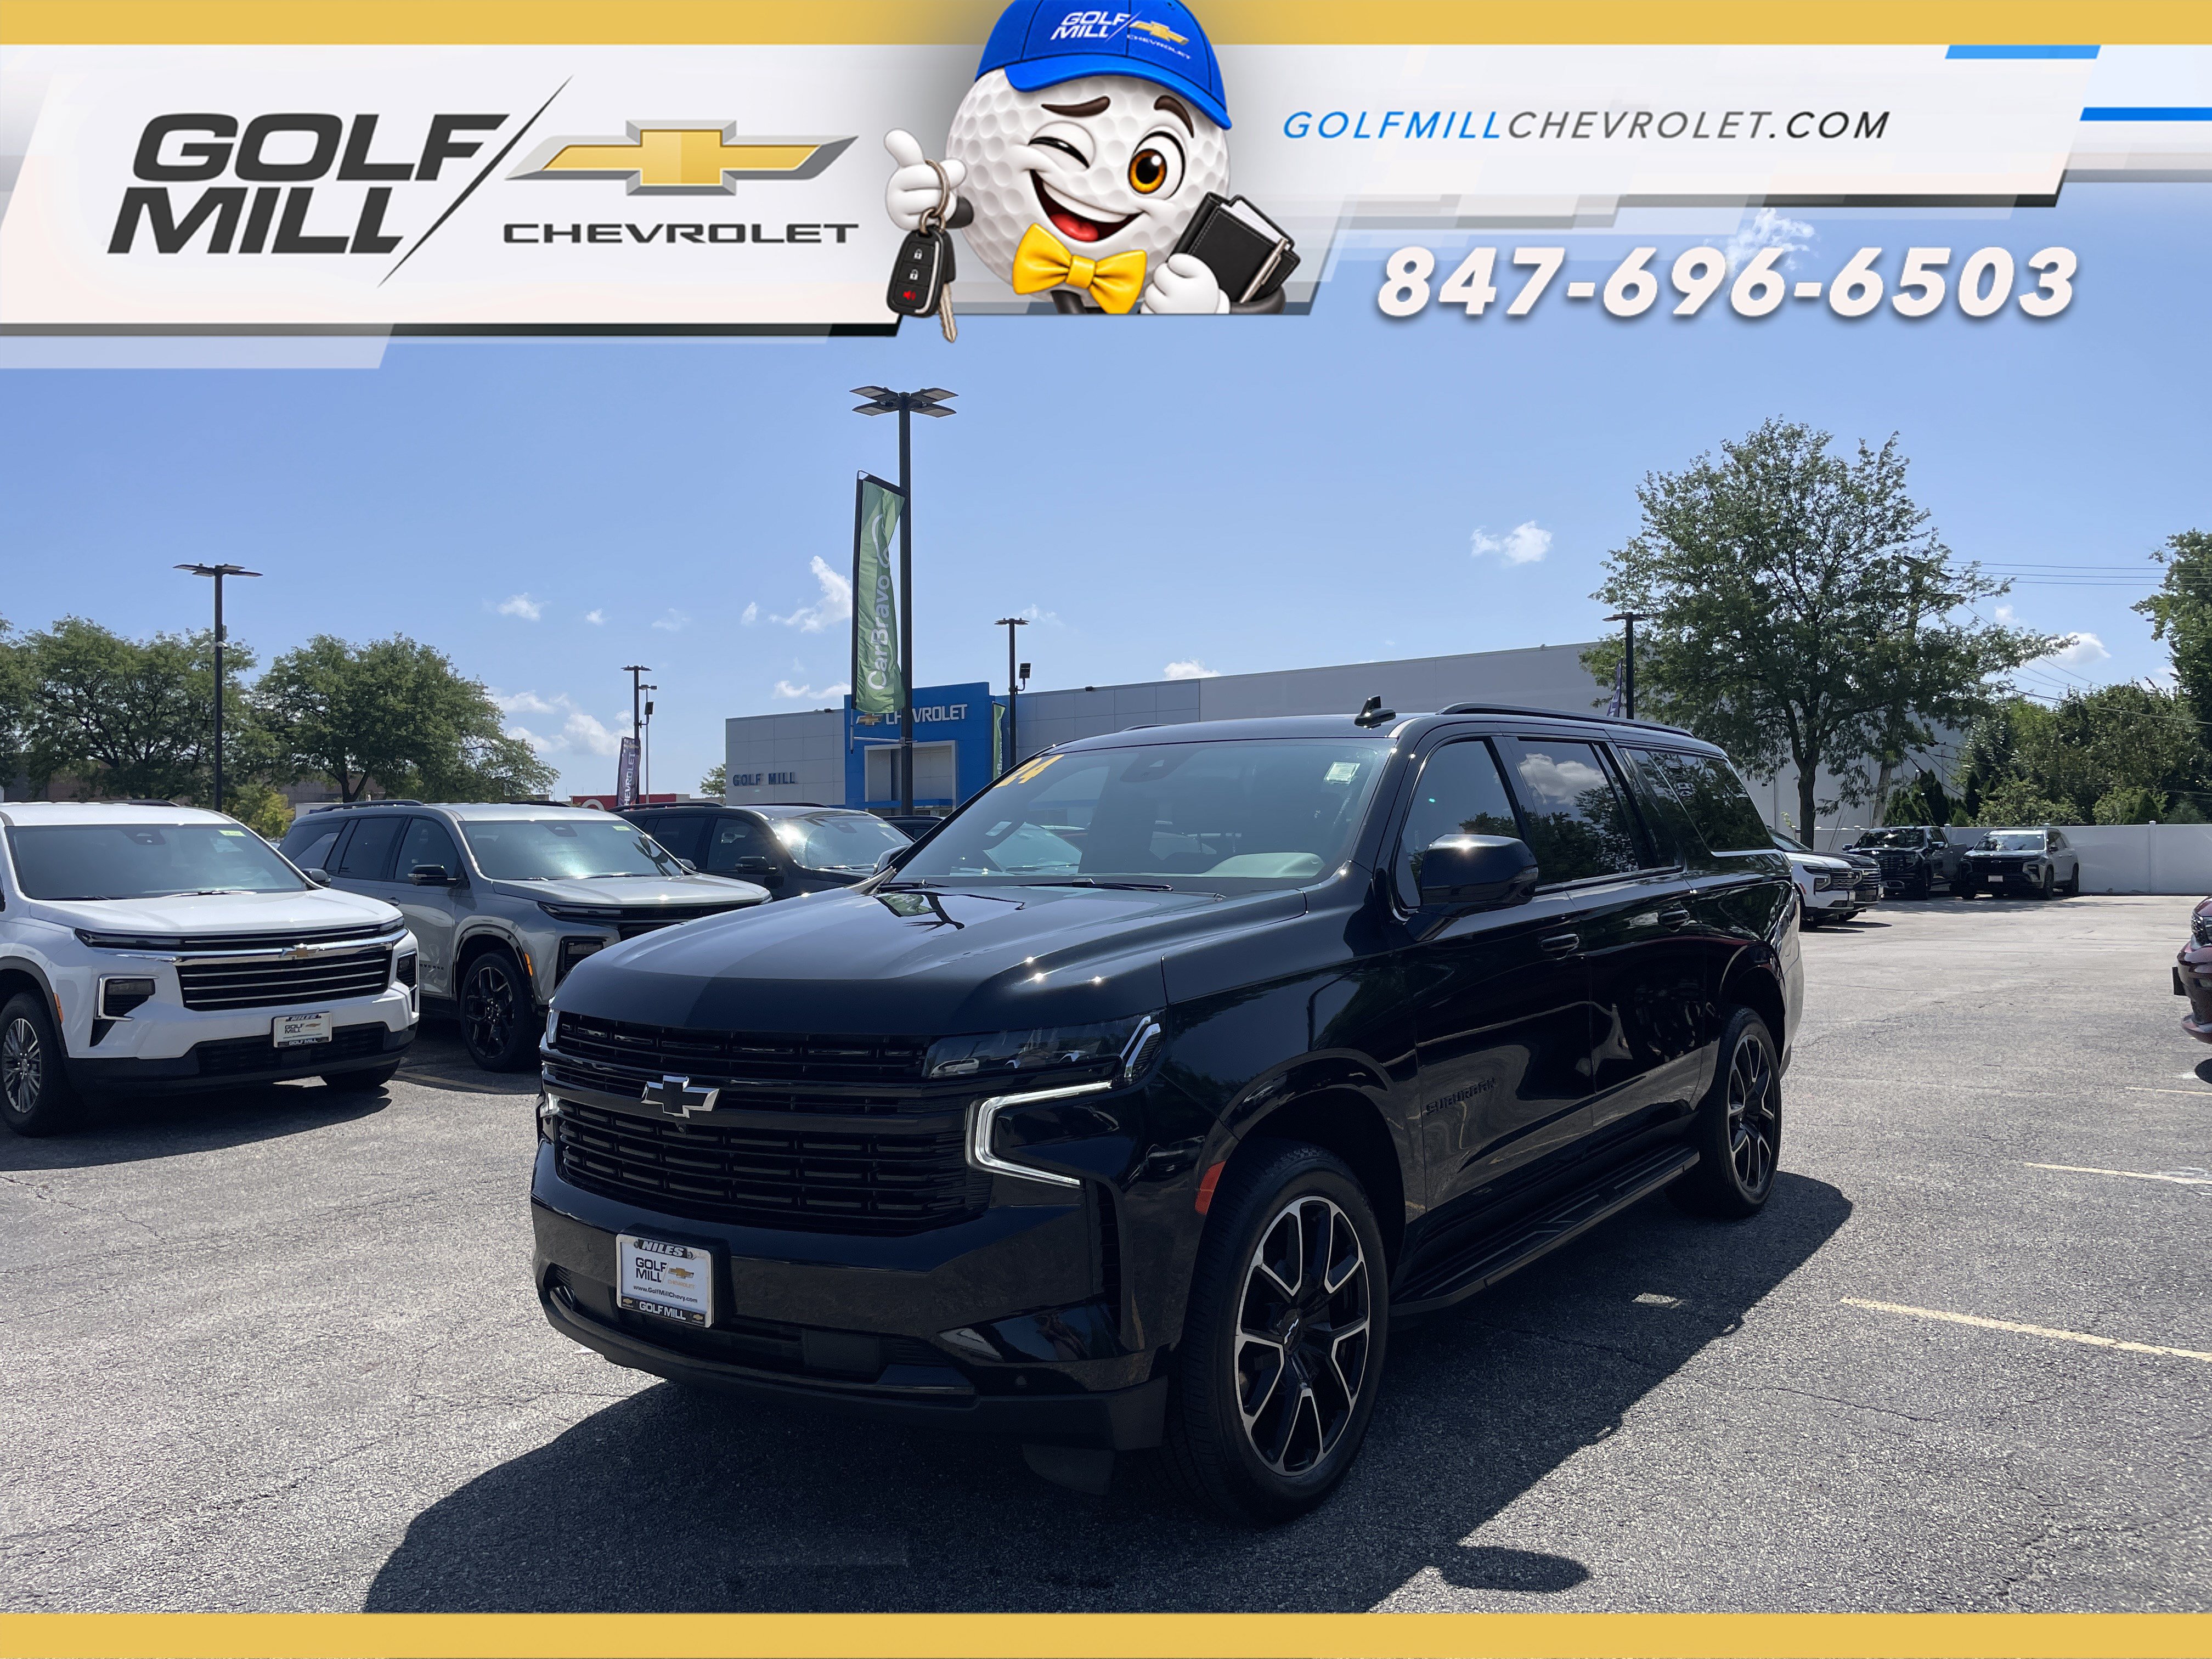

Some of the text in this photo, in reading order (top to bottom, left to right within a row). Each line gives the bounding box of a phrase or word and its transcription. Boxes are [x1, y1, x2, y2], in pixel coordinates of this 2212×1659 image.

[868, 575, 890, 690] CarBravo
[885, 704, 967, 725] CHVROLET
[733, 772, 795, 786] GOLF MILL
[642, 1240, 684, 1257] NILES
[636, 1257, 667, 1272] GOLF
[636, 1268, 662, 1283] MILL
[633, 1285, 698, 1304] www.GolfMillChevy.com
[639, 1301, 686, 1321] GOLF MILL
